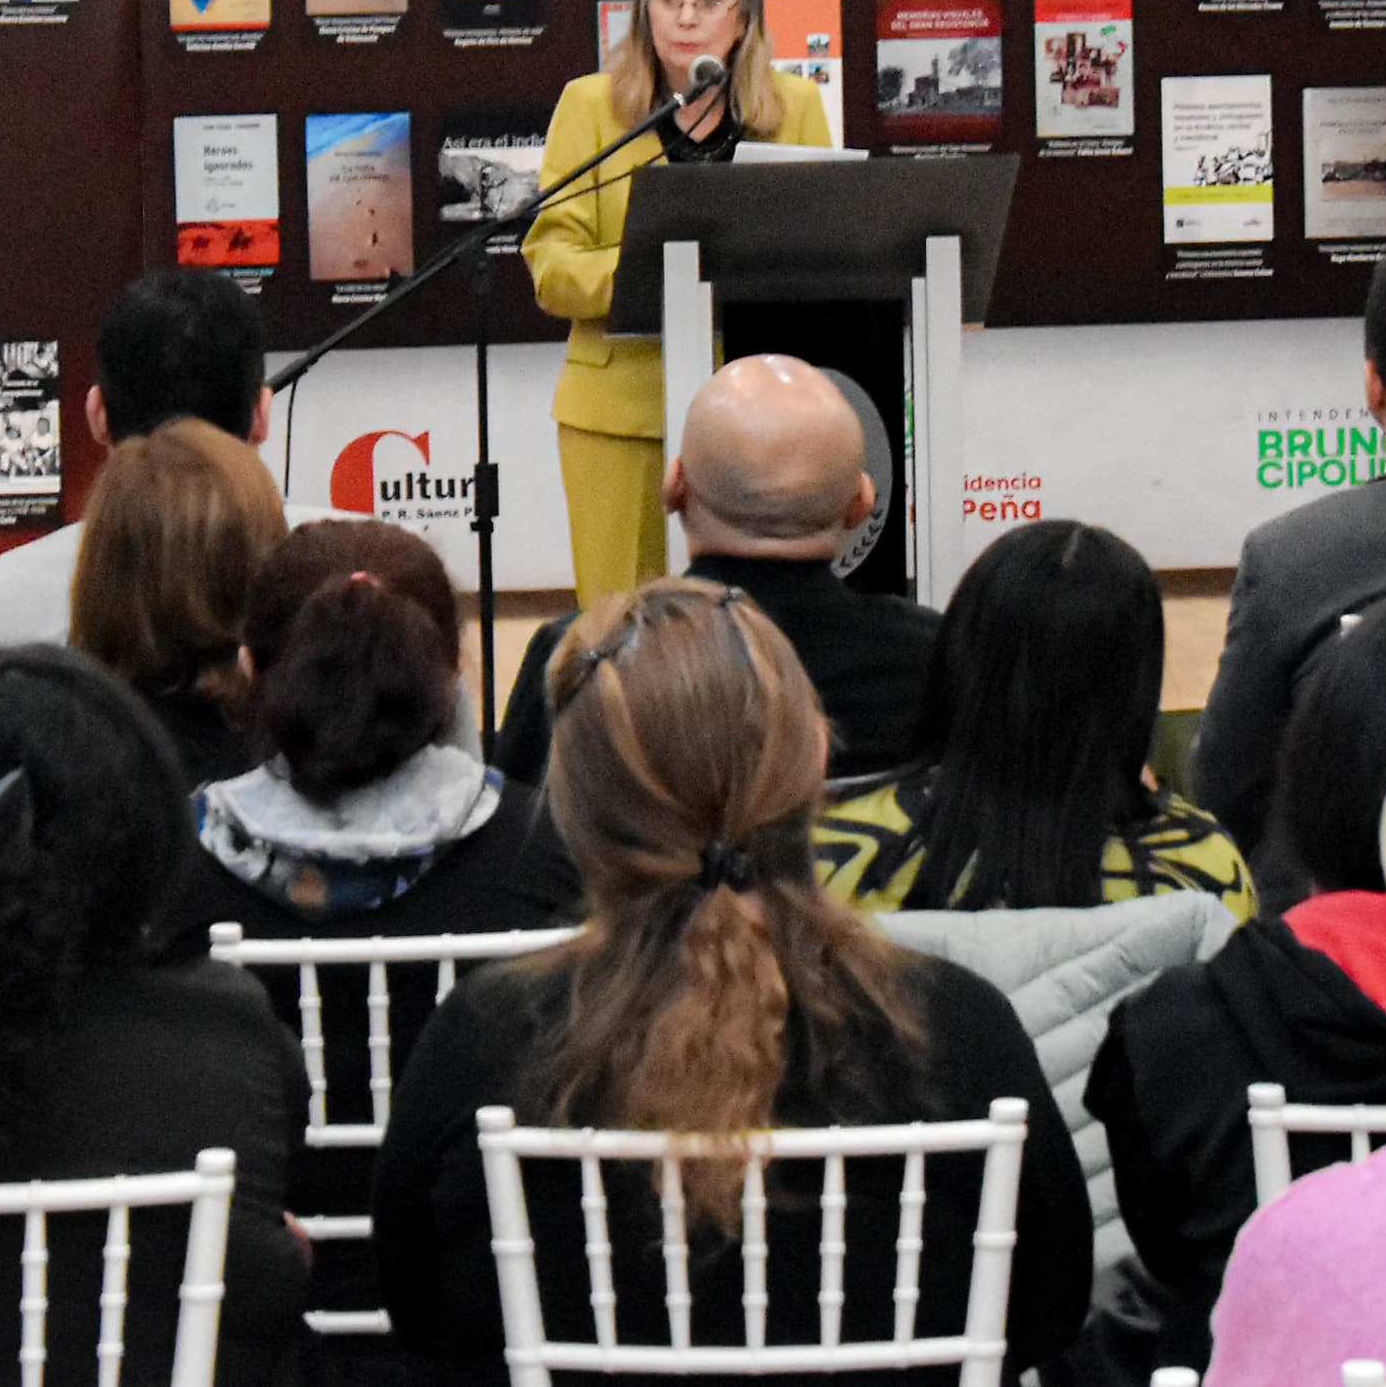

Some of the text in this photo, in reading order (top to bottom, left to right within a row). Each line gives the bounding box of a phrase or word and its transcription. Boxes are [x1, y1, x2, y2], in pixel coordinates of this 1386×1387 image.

[1258, 407, 1370, 423] INTENDEN
[330, 430, 476, 515] Cultur
[963, 472, 1042, 492] idencia
[1257, 458, 1386, 489] CIPOLI
[963, 493, 1042, 522] Peña
